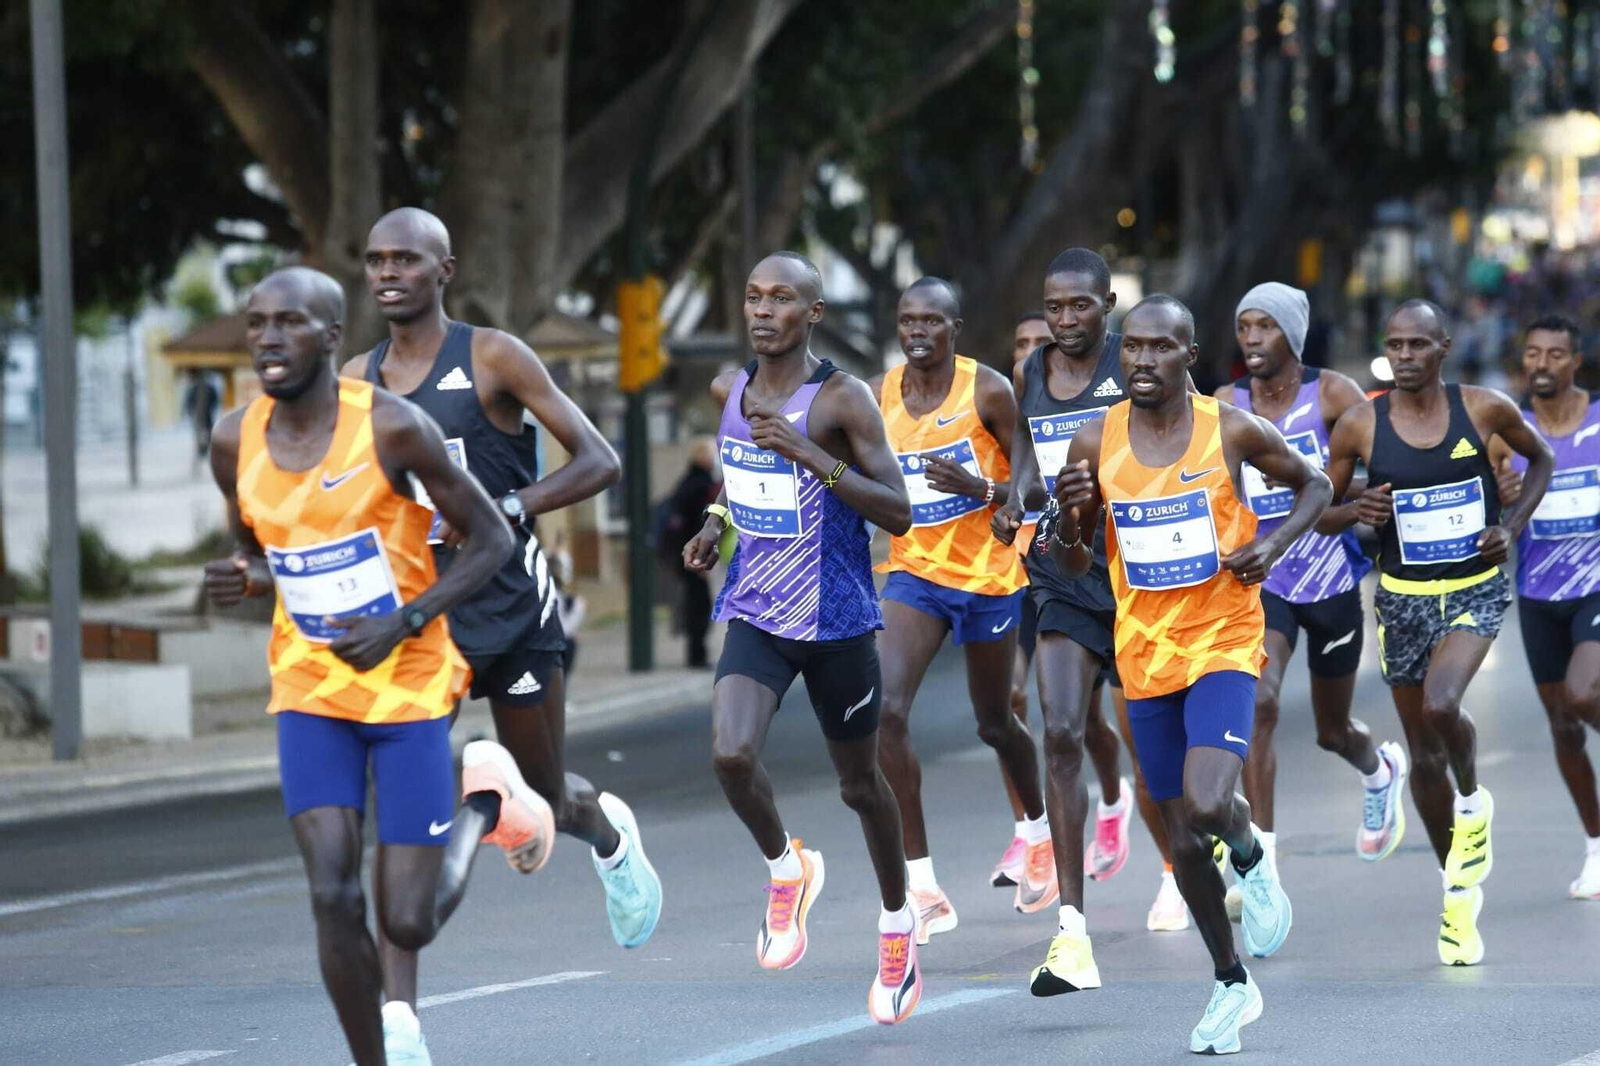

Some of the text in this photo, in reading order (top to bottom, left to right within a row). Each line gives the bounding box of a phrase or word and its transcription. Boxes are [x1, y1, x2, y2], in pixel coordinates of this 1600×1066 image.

[742, 451, 775, 464] ZURICH
[759, 482, 765, 494] 1
[1429, 490, 1466, 502] ZURICH
[1145, 502, 1188, 517] ZURICH
[1448, 514, 1464, 525] 12
[1172, 532, 1183, 544] 4
[507, 683, 542, 695] adidas
